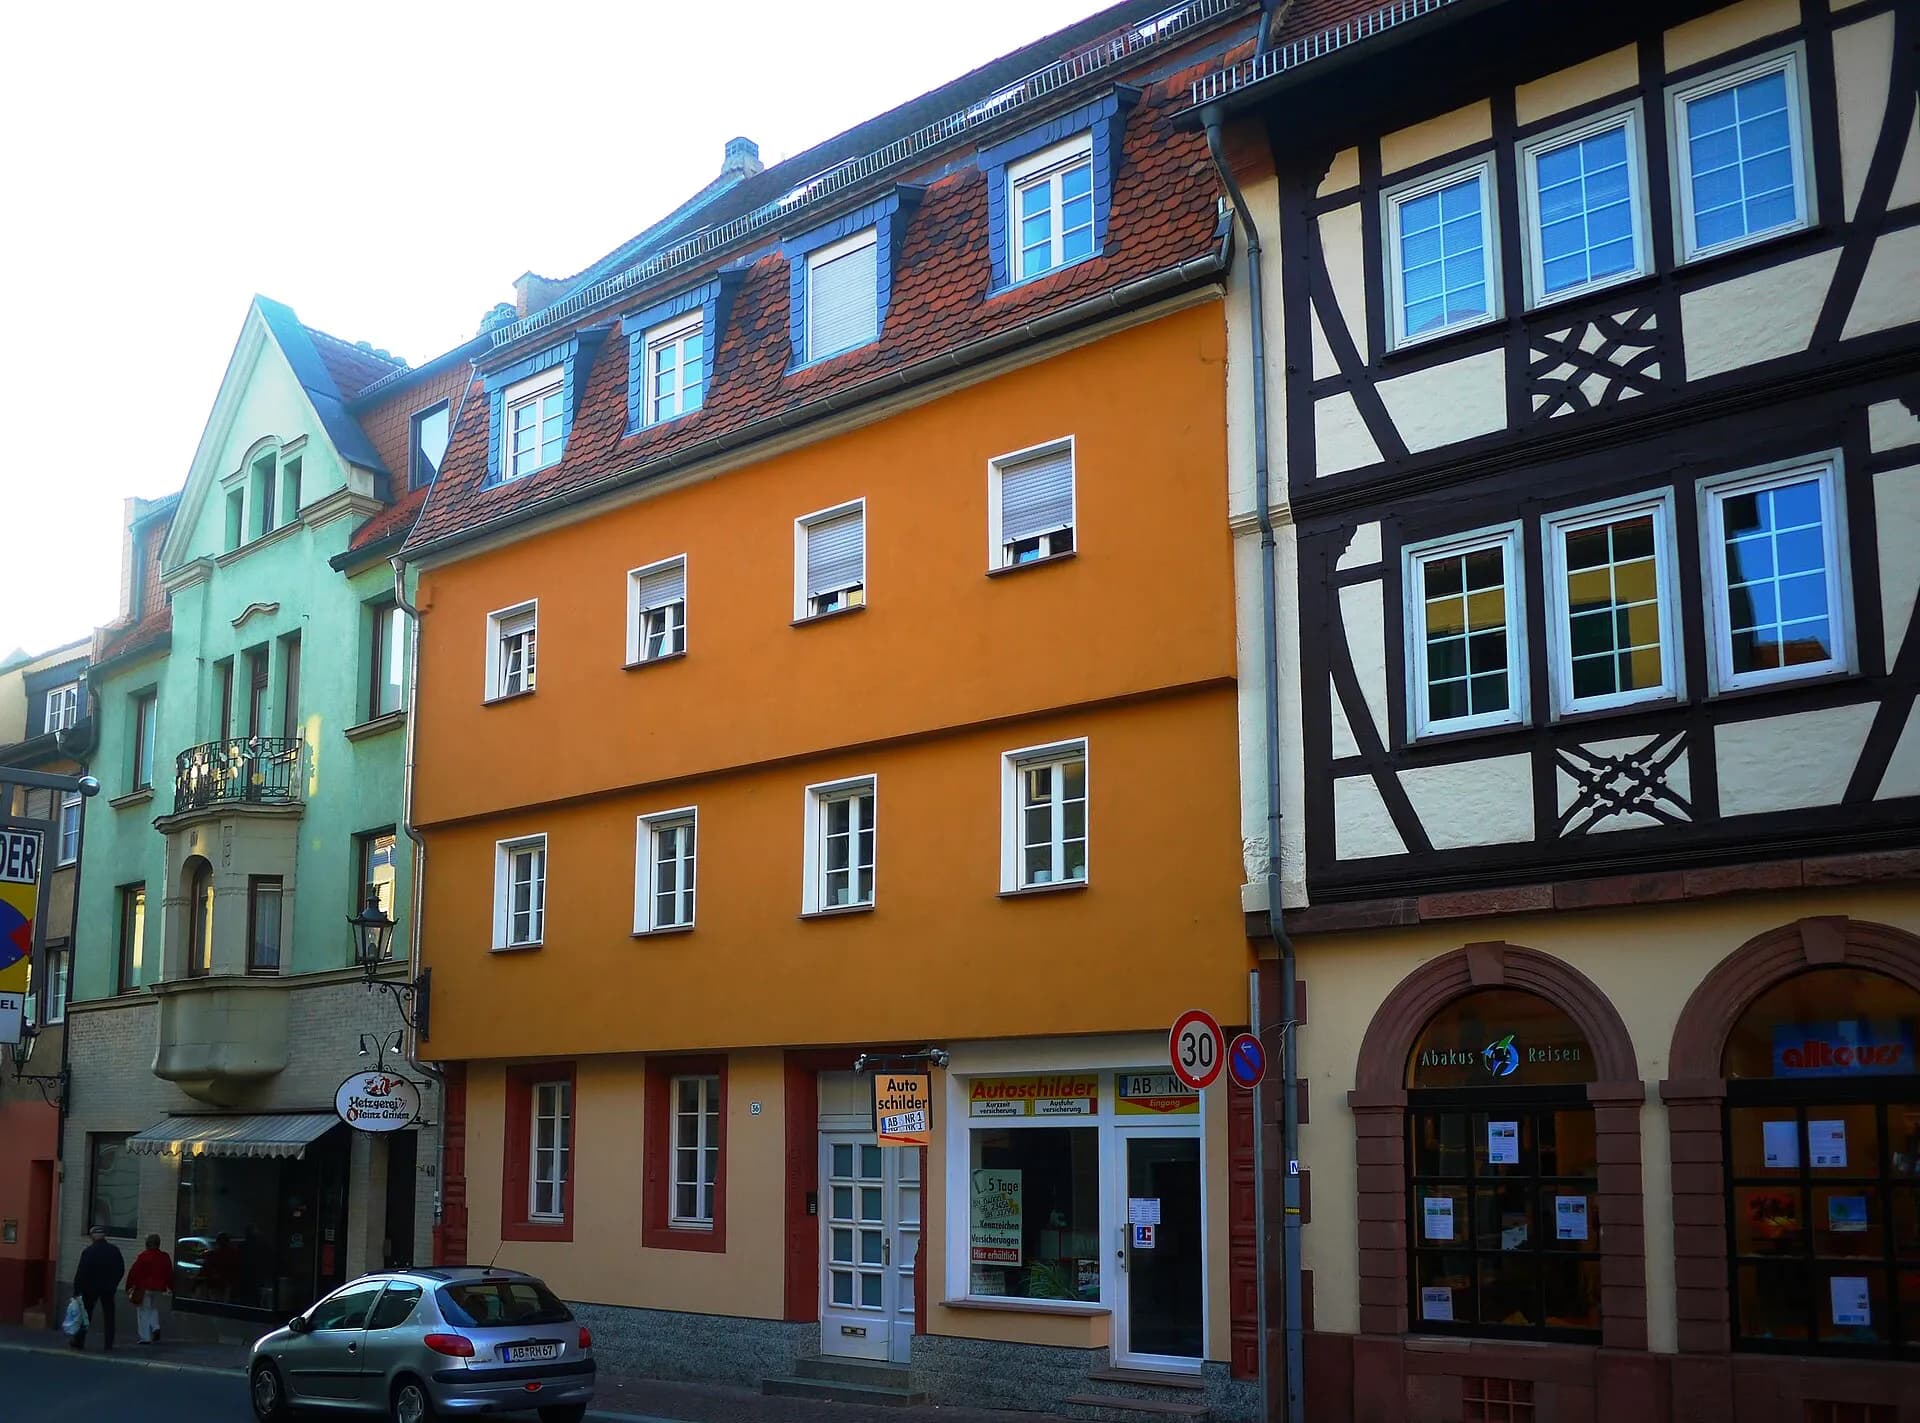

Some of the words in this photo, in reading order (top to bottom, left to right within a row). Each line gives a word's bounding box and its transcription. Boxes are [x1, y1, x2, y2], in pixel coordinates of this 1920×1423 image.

[1182, 1032, 1213, 1067] 30
[1421, 1050, 1474, 1066] Abakus
[1529, 1046, 1581, 1062] Reisen
[1783, 1040, 1904, 1068] alltours
[887, 1079, 918, 1092] Auto
[972, 1076, 1096, 1099] Autoschilder
[1132, 1077, 1151, 1094] AB
[348, 1096, 399, 1110] Metzgerei
[878, 1095, 928, 1110] schilder
[1049, 1099, 1075, 1107] Ausfuhr
[1150, 1099, 1180, 1107] Eingang
[979, 1107, 1017, 1115] versicherung
[1042, 1106, 1081, 1114] versicherung
[888, 1117, 898, 1128] AB
[904, 1113, 916, 1124] NR
[917, 1112, 922, 1122] 1
[997, 1179, 1018, 1195] Tage
[972, 1234, 1019, 1246] Versicherungen
[973, 1248, 986, 1259] Hier
[987, 1248, 1017, 1261] erhältlich
[512, 1347, 525, 1359] AB
[529, 1346, 541, 1358] RH
[542, 1345, 553, 1356] 67
